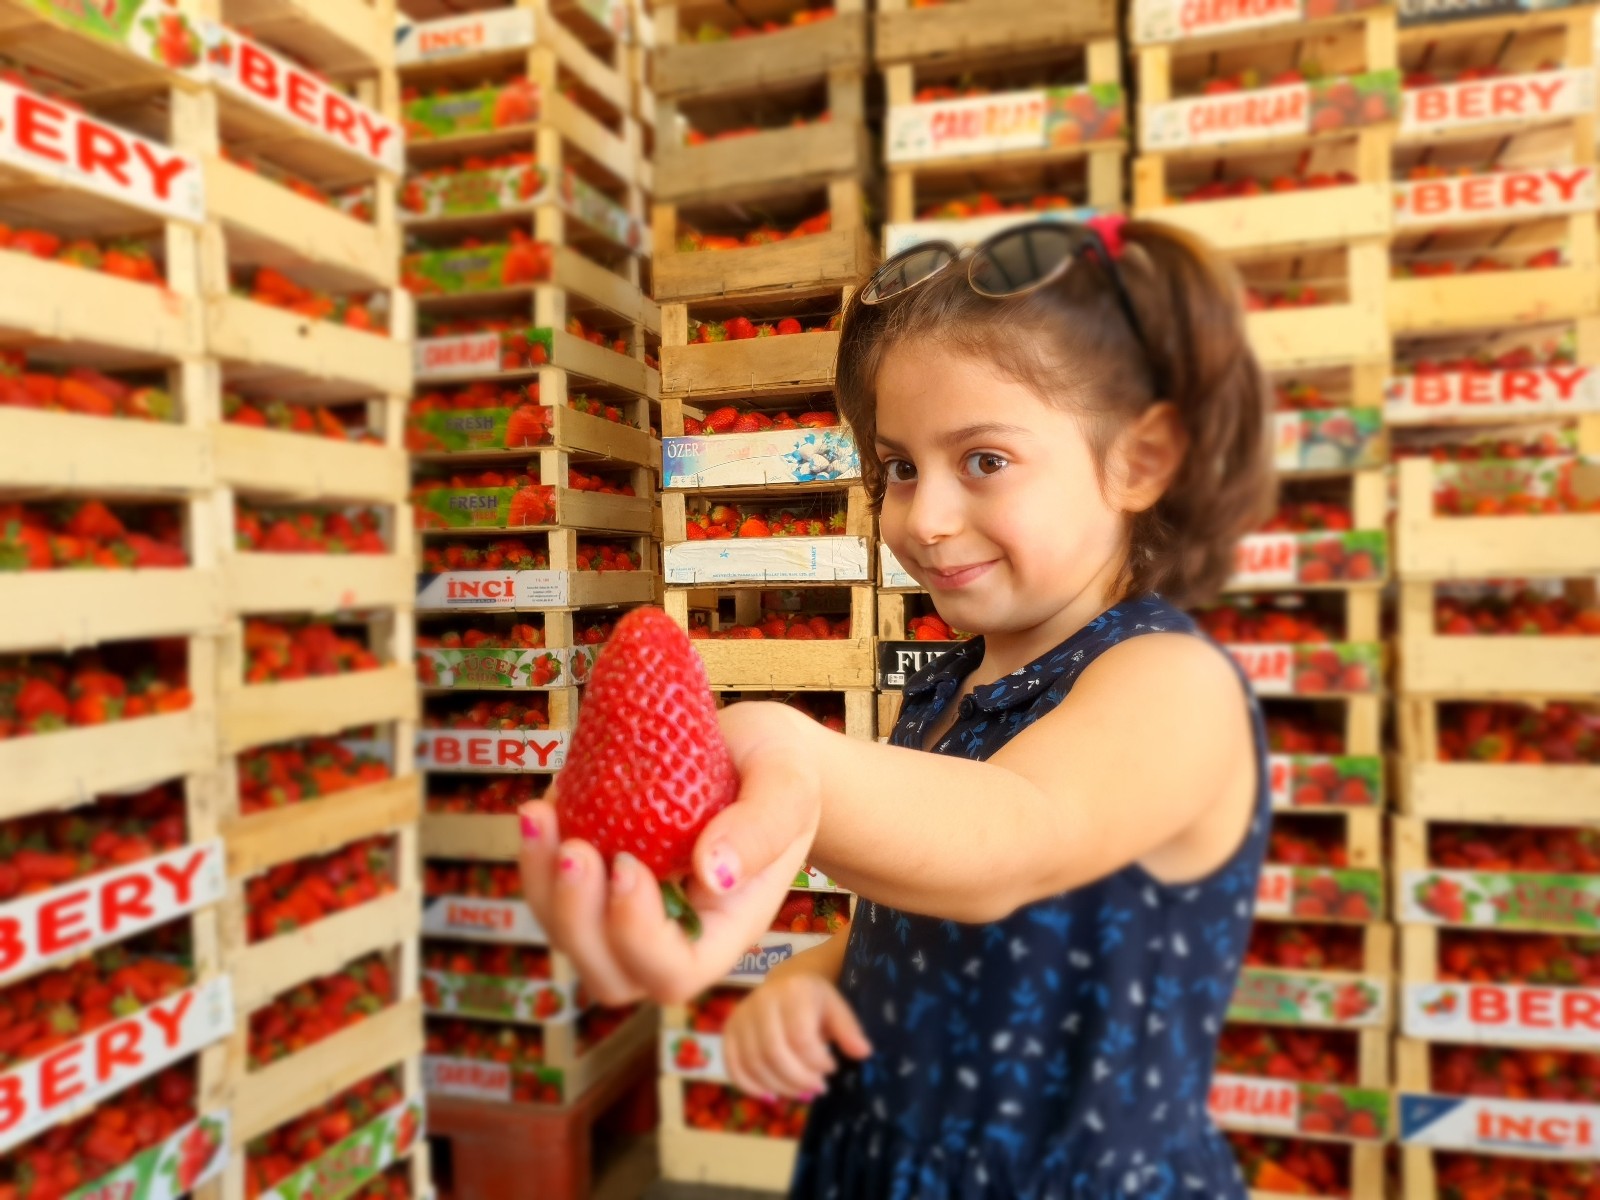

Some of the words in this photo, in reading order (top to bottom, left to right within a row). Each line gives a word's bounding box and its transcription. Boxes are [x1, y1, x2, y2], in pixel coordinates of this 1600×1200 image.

[238, 42, 394, 158] BERY
[1415, 80, 1565, 122] BERY
[0, 93, 188, 200] ERY
[1411, 168, 1592, 215] BERY
[1410, 366, 1589, 406] BERY
[667, 440, 700, 459] ÖZER
[449, 495, 498, 509] FRESH
[447, 576, 515, 598] İNCİ
[448, 653, 519, 680] YÜCEL
[895, 650, 947, 673] FU
[433, 736, 560, 767] BERY
